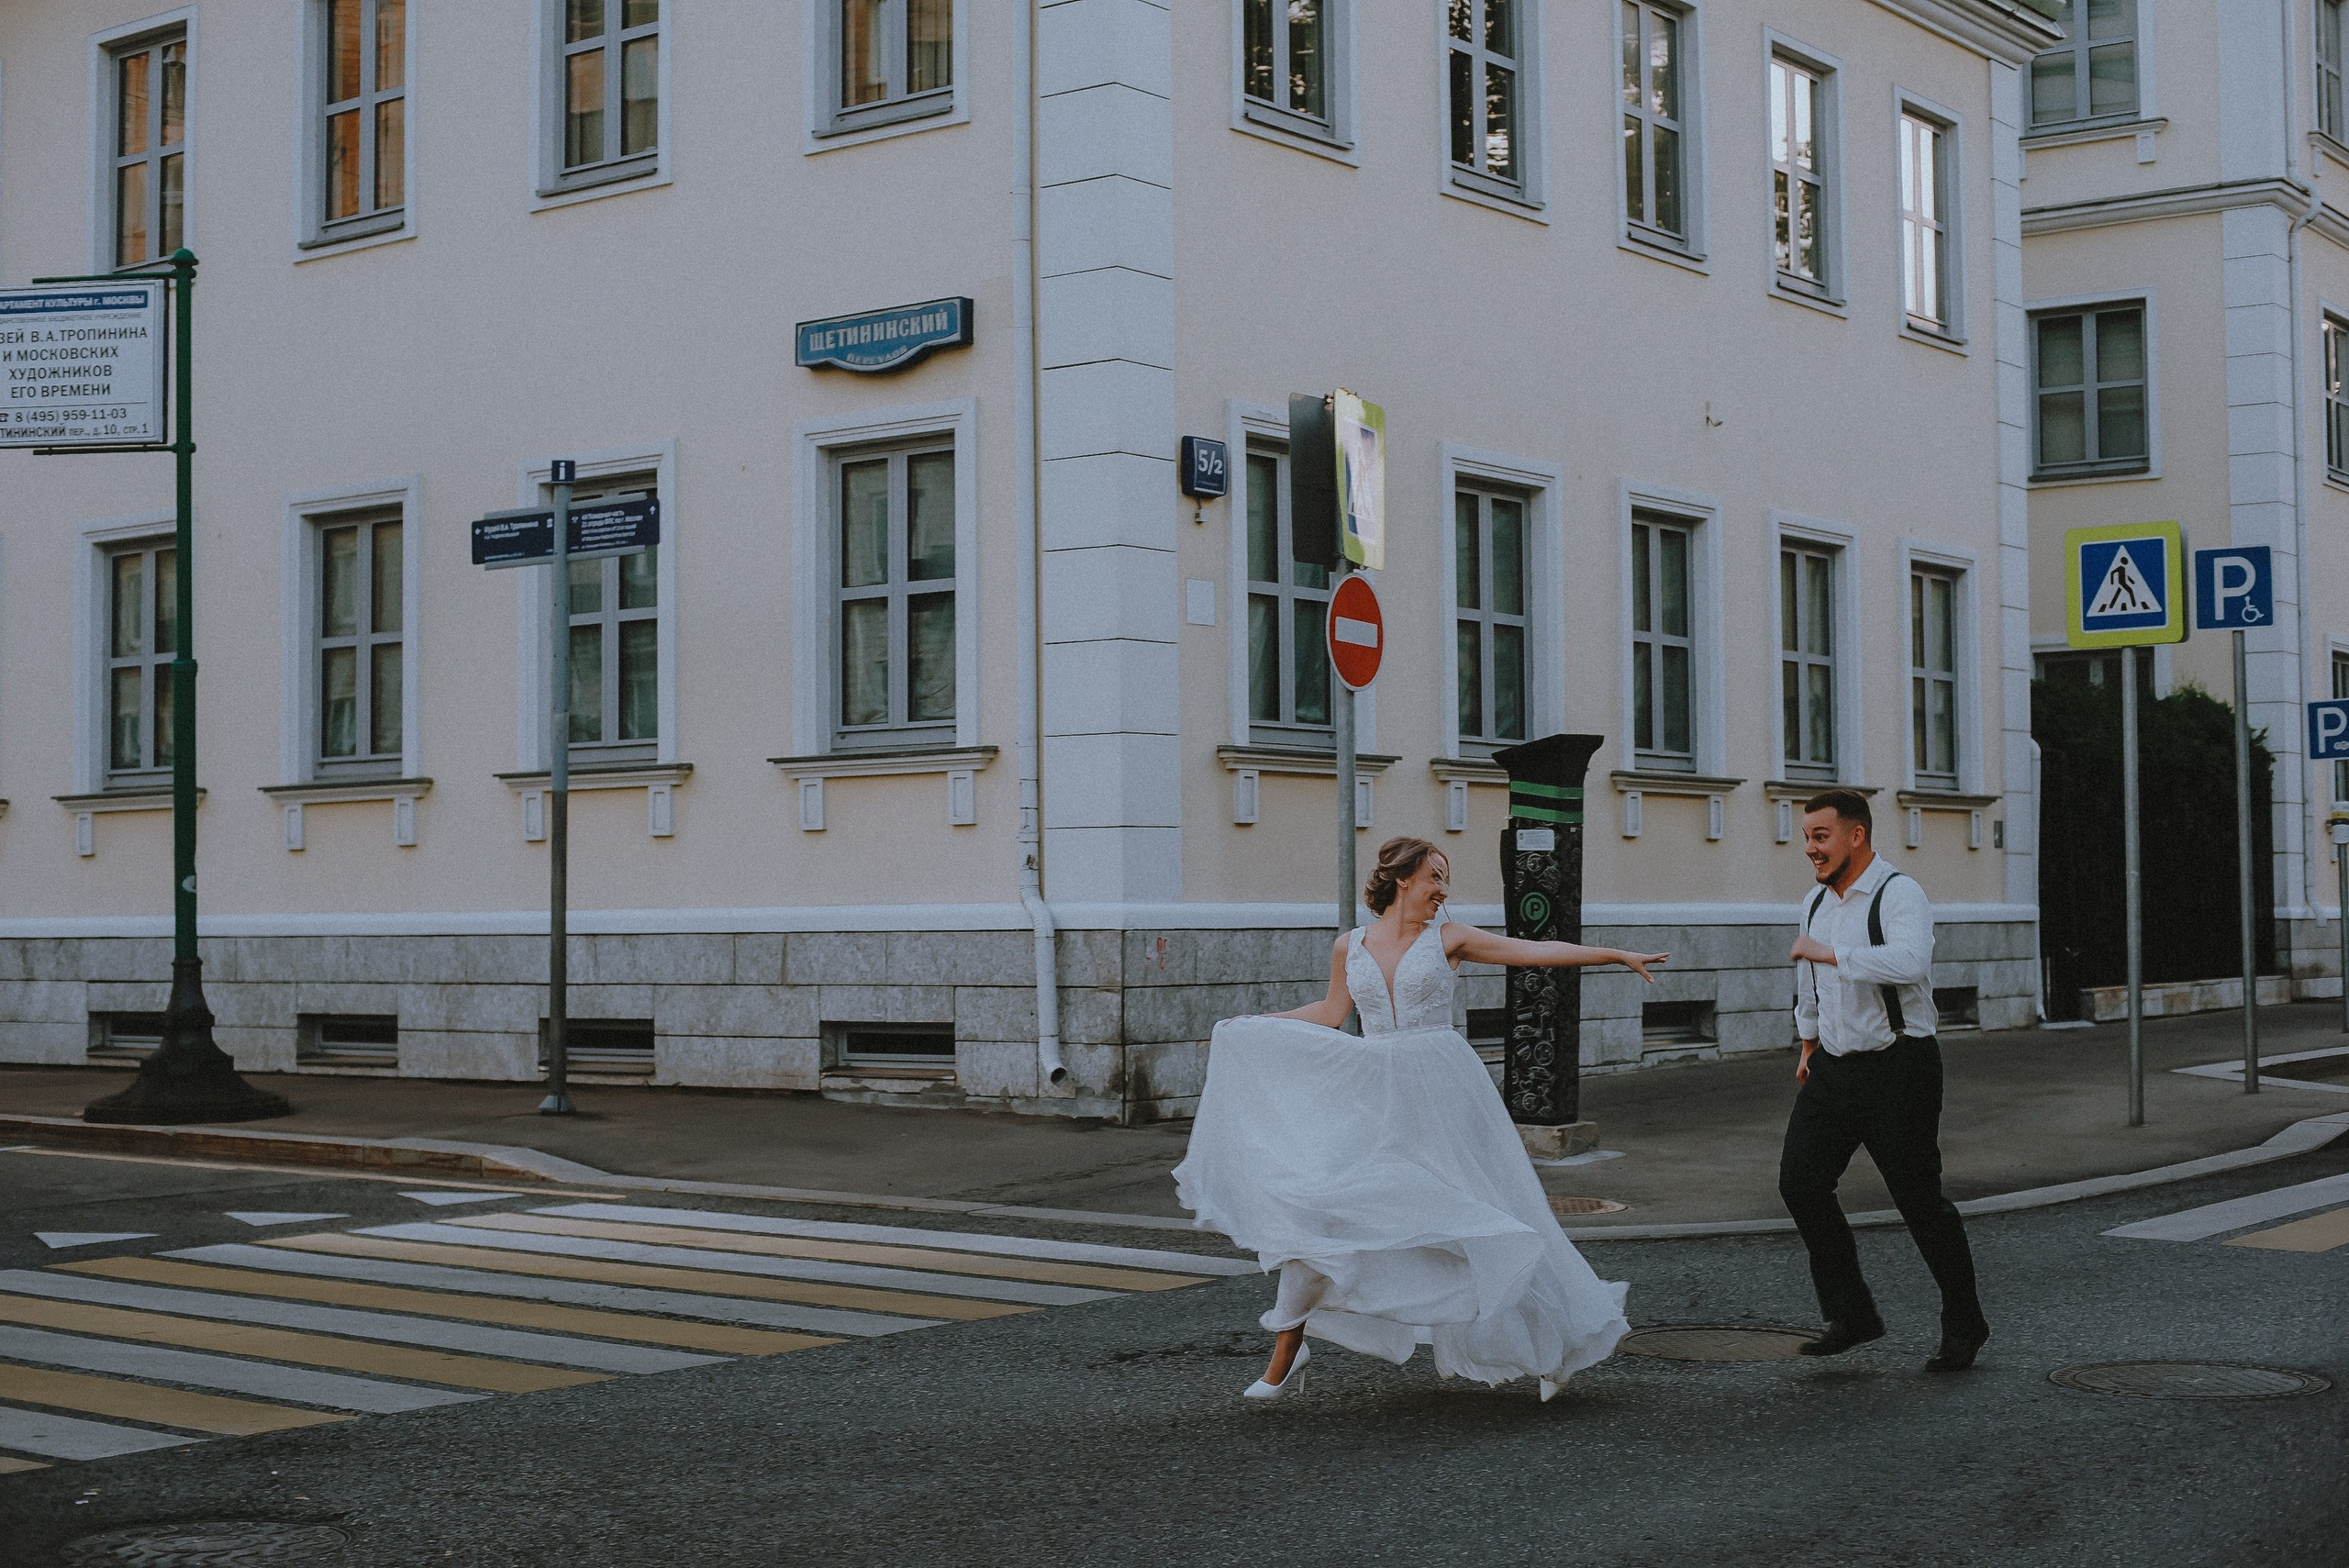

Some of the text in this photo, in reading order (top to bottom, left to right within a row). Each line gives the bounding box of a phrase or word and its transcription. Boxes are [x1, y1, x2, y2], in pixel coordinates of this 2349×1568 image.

[102, 295, 145, 306] МОСКВЫ
[809, 309, 949, 351] ЩЕТИНИНСКИЙ
[3, 346, 119, 362] И МОСКОВСКИХ
[8, 365, 113, 382] ХУДОЖНИКОВ
[11, 384, 111, 399] ЕГО ВРЕМЕНИ
[16, 408, 128, 424] 8 (495) 959-11-03
[1197, 449, 1223, 475] 5/2
[2212, 555, 2256, 621] P
[2317, 706, 2348, 754] P
[1530, 902, 1542, 917] P
